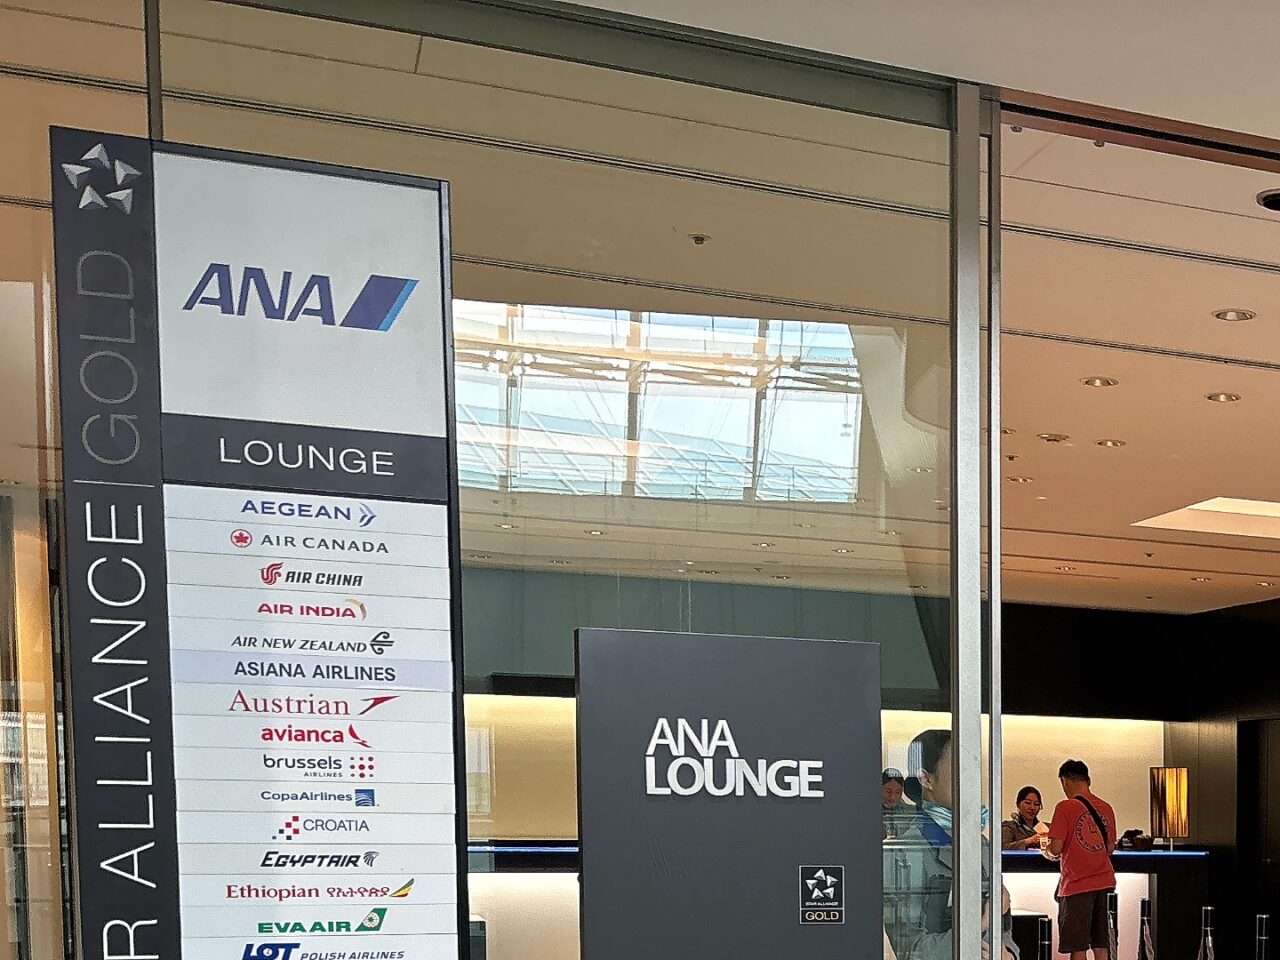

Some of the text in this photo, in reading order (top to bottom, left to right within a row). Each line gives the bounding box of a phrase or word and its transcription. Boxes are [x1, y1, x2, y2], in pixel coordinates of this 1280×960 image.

[183, 262, 337, 327] ANA
[76, 249, 141, 466] GOLD
[219, 437, 396, 477] LOUNGE
[240, 500, 351, 521] AEGEAN
[260, 534, 389, 554] AIR CANADA
[284, 570, 363, 587] AIR CHINA
[257, 603, 356, 619] AIR INDIA
[231, 635, 368, 653] AIR NEW ZEALAND
[234, 661, 397, 682] ASIANA AIRLINES
[85, 501, 158, 889] ALLIANCE
[228, 689, 351, 716] Austrian
[261, 724, 345, 743] avianca
[645, 717, 740, 758] ANA
[263, 754, 342, 770] brussels
[645, 755, 825, 798] LOUNGE
[303, 819, 370, 832] CROATIA
[225, 884, 319, 901] Ethiopian
[805, 911, 839, 921] GOLD
[300, 951, 405, 960] POLISH AIRLINES
